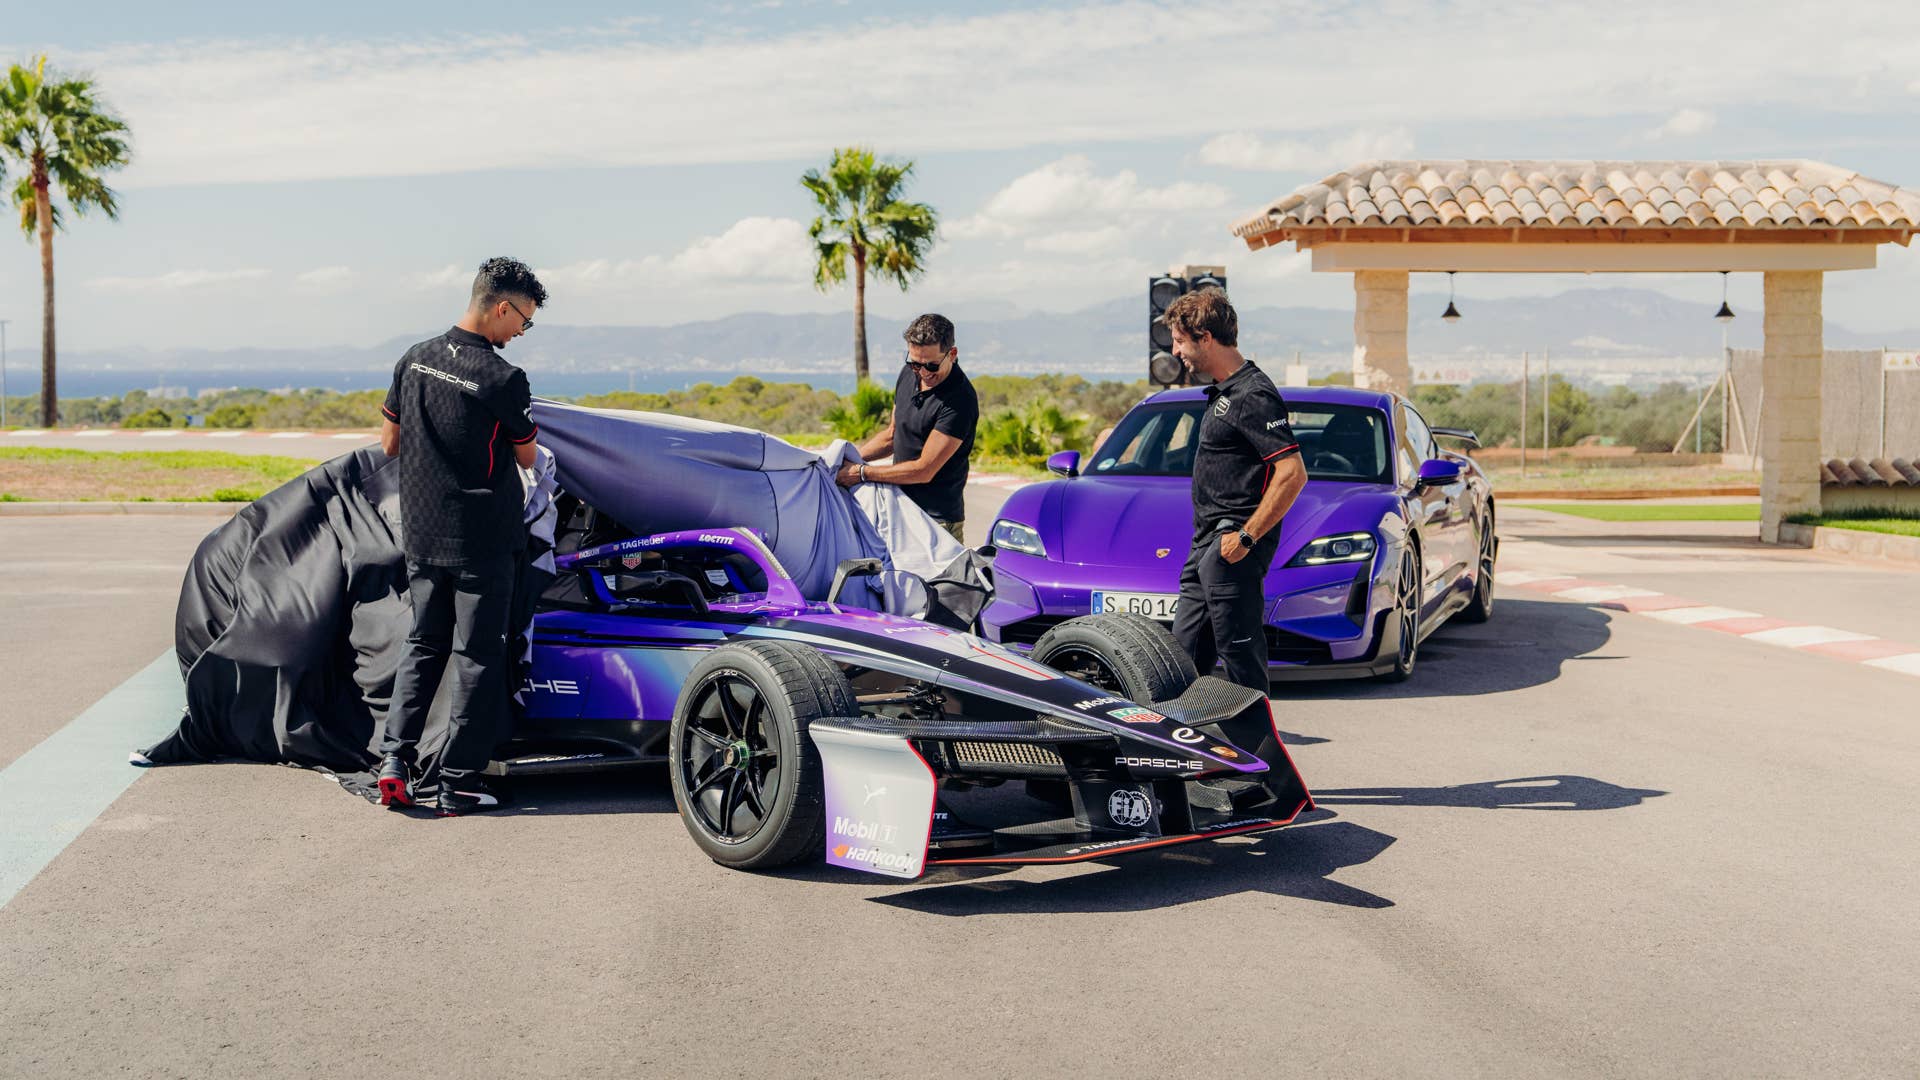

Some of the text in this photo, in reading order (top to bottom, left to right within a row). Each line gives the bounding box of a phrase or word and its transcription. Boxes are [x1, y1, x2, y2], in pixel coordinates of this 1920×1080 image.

[410, 362, 480, 392] PORSCHE
[698, 534, 735, 545] LOCTITE
[1104, 597, 1116, 613] S
[1115, 757, 1203, 770] PORSCHE
[833, 816, 879, 841] Mobil
[846, 847, 919, 870] Hankook
